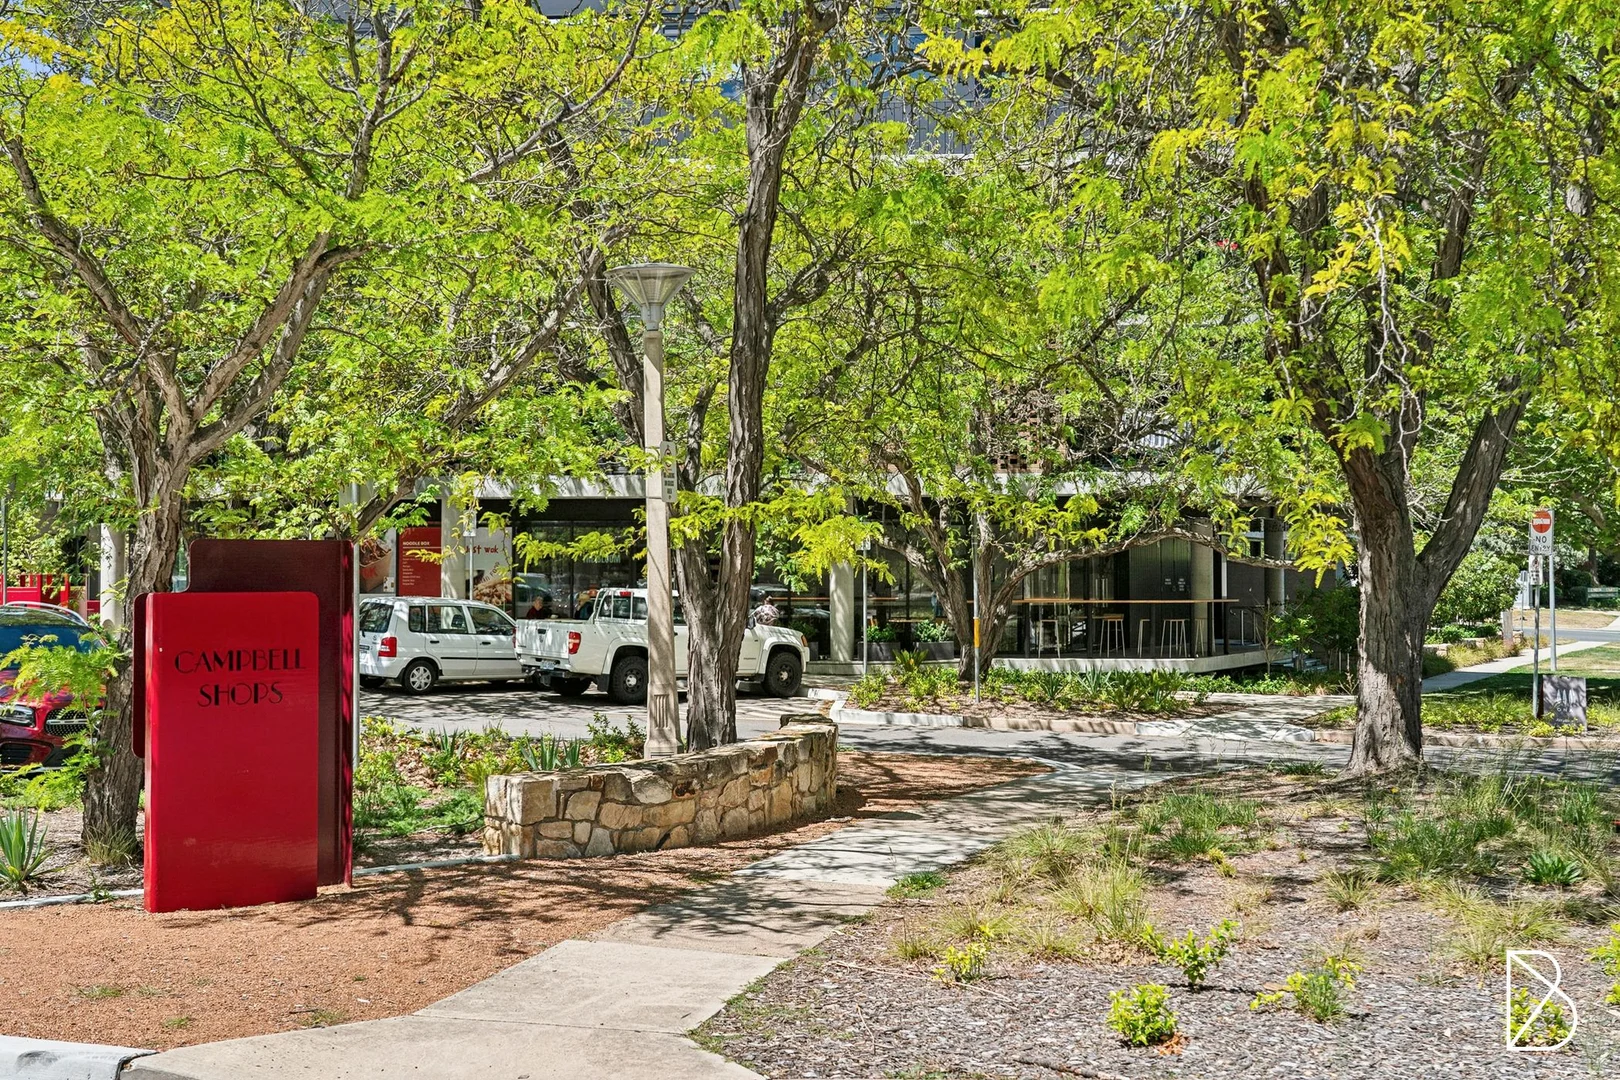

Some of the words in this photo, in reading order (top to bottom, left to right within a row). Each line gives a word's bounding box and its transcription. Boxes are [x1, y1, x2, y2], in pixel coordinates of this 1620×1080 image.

[1535, 535, 1547, 544] NO
[465, 545, 481, 554] Jst
[484, 545, 499, 554] wok
[174, 647, 307, 674] CAMPBELL
[196, 681, 283, 708] SHOPS
